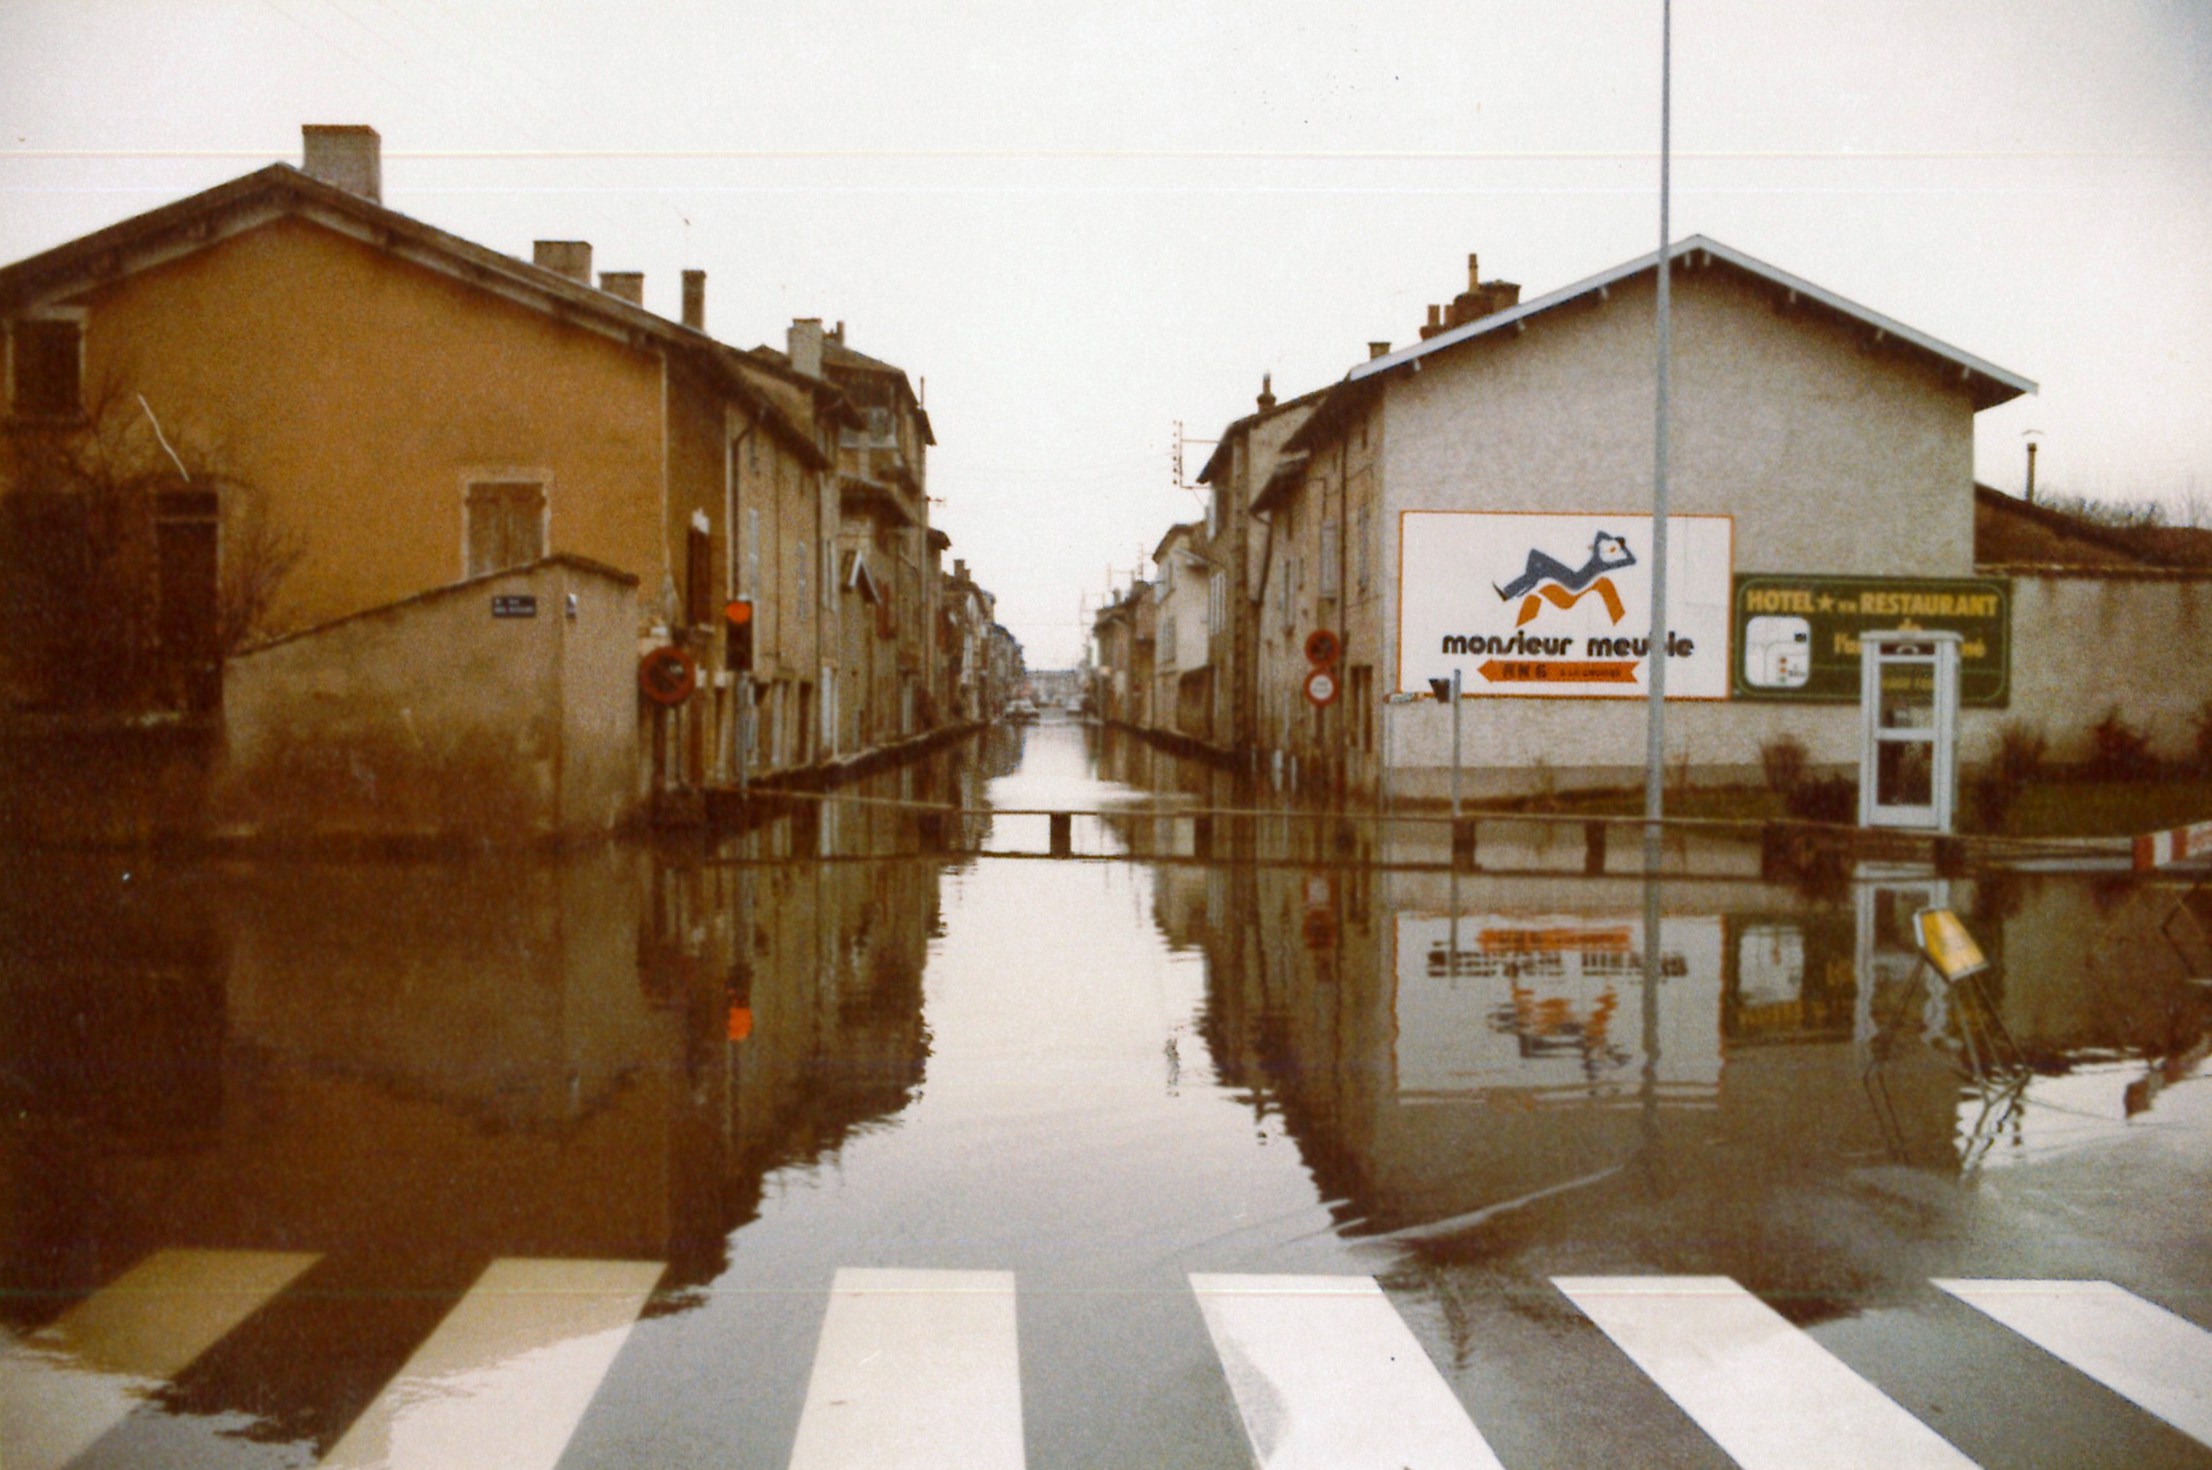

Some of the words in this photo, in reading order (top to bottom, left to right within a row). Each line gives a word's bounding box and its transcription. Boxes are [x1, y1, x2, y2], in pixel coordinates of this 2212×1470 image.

[1747, 589, 1814, 613] HOTEL
[1860, 592, 1997, 617] RESTAURANT
[1442, 630, 1573, 656] monsieur
[1587, 631, 1695, 658] meule
